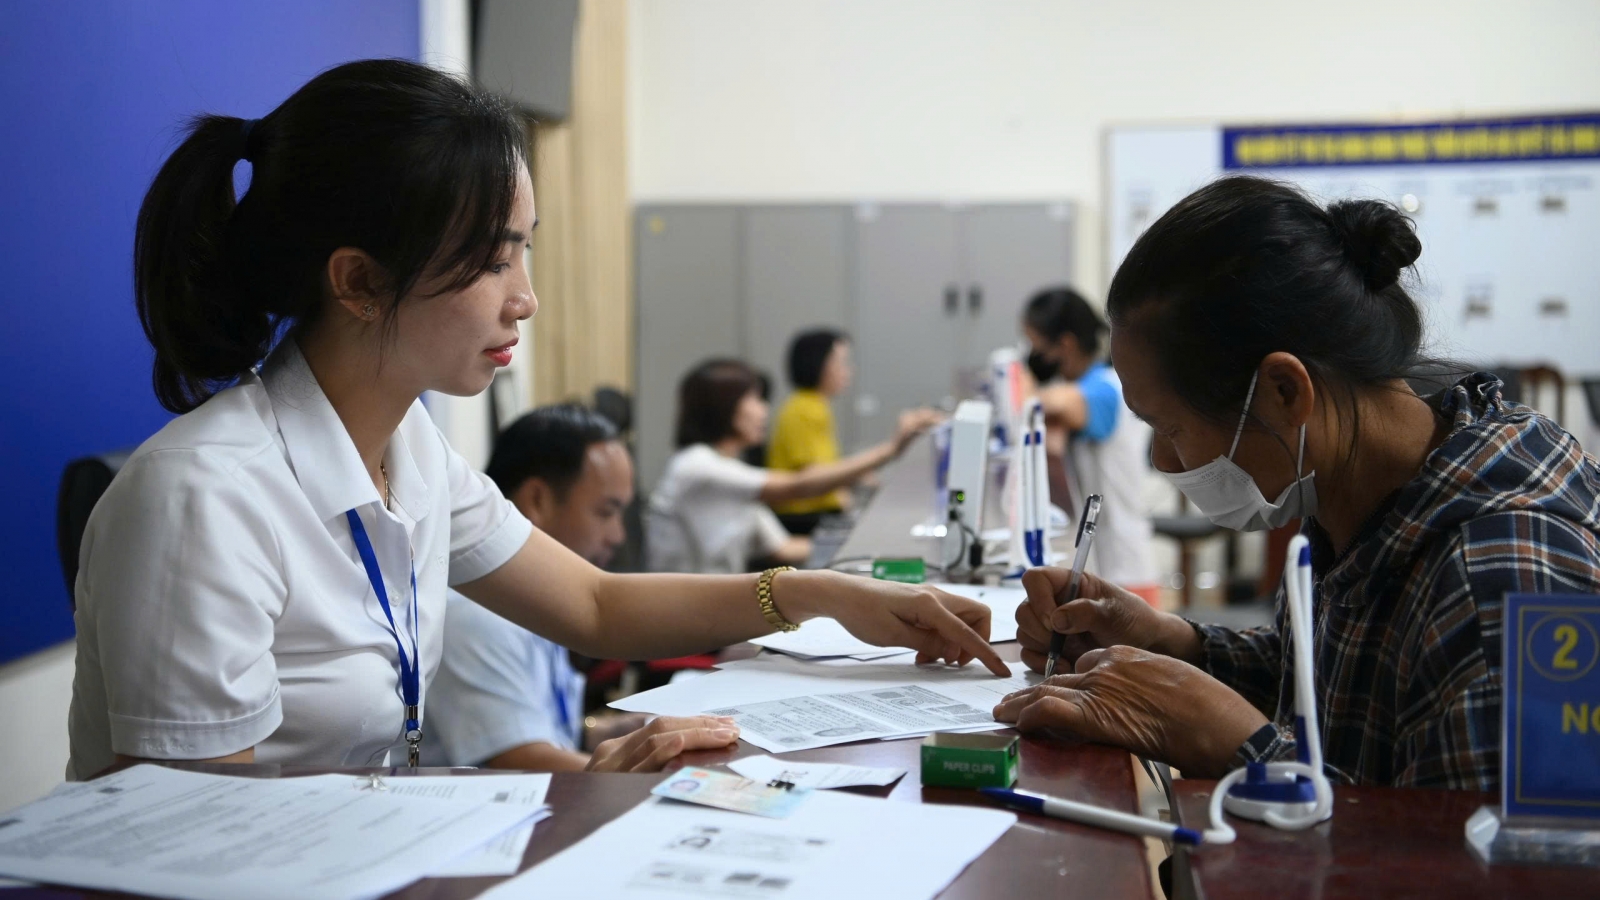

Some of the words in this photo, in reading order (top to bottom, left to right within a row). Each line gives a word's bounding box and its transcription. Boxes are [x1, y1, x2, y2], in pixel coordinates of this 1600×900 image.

[1552, 624, 1579, 669] 2
[943, 761, 970, 772] PAPER
[971, 762, 995, 774] CLIPS
